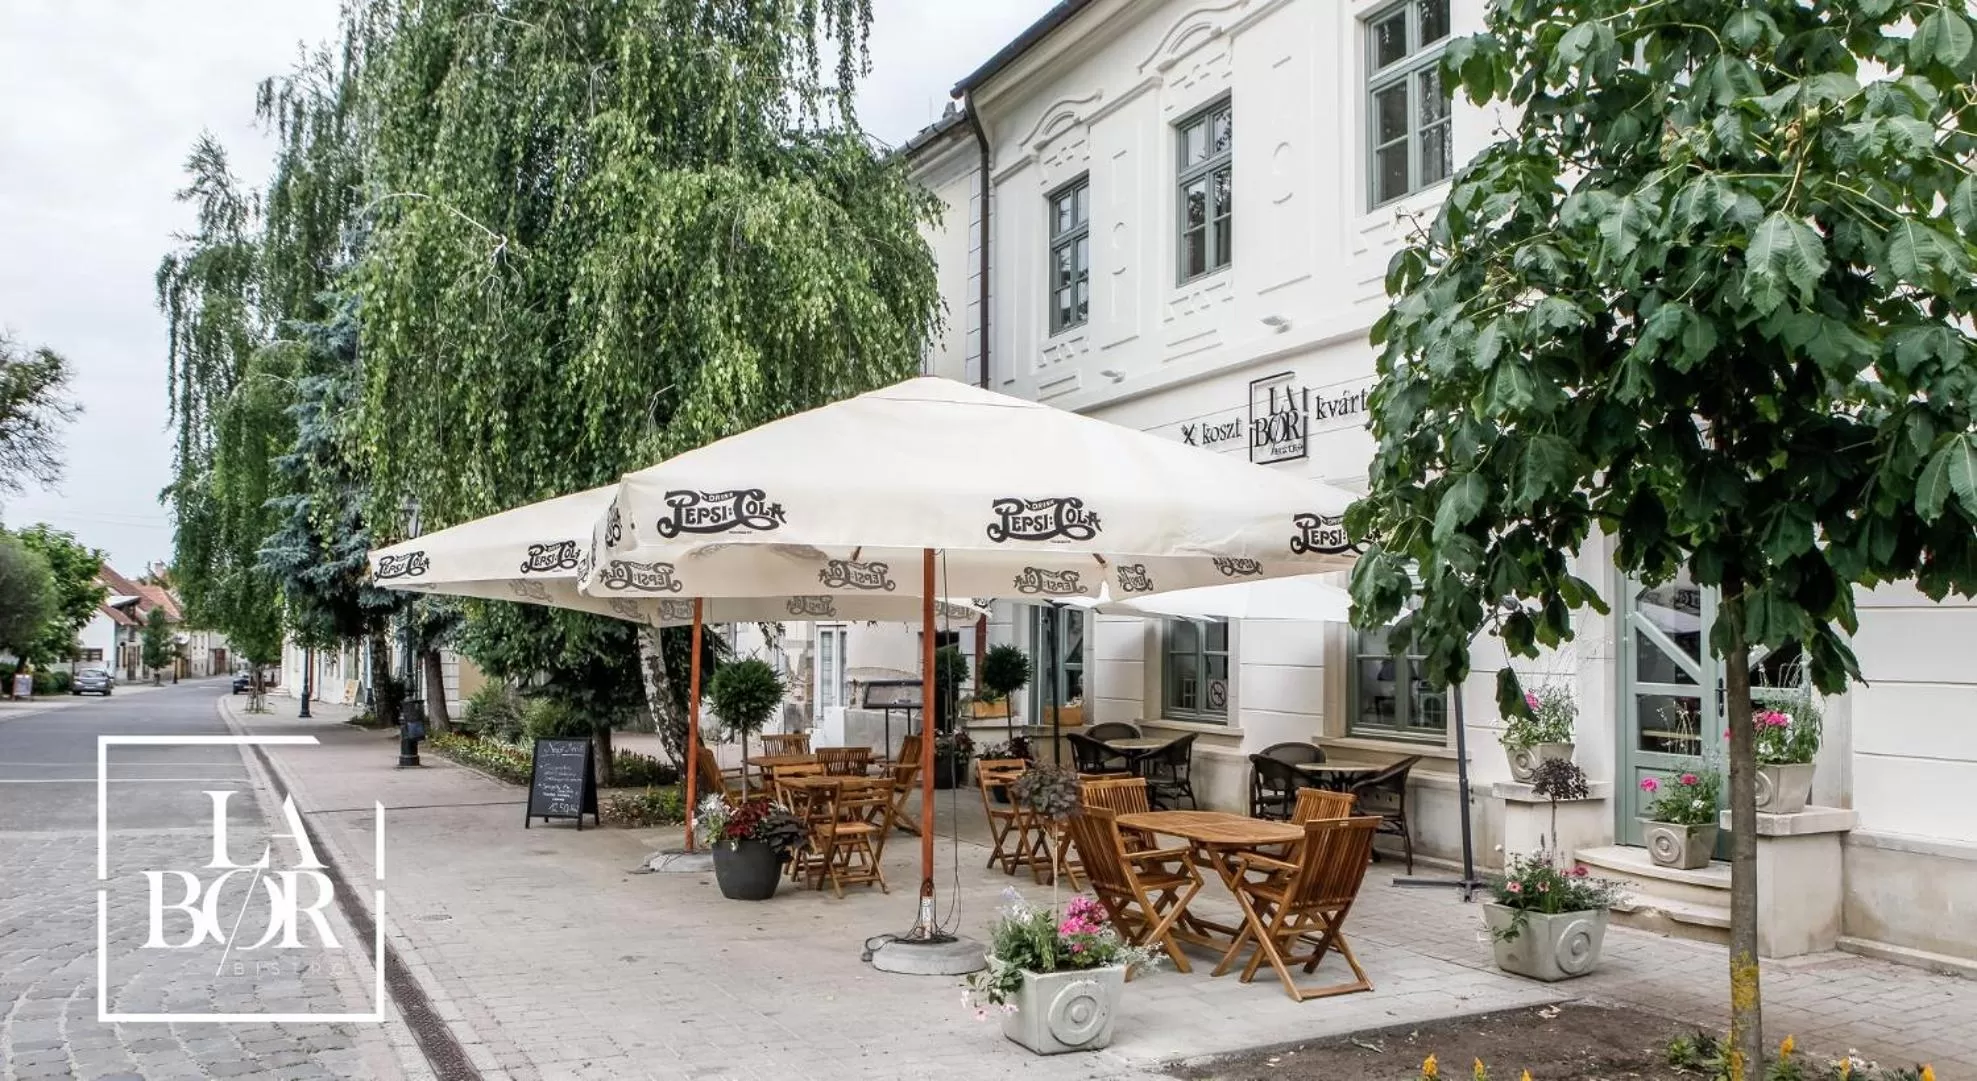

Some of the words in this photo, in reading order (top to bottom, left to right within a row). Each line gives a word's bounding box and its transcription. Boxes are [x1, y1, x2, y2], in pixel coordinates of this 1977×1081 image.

[1268, 384, 1299, 416] LA
[1315, 386, 1372, 420] kvárt
[1202, 416, 1243, 445] koszt
